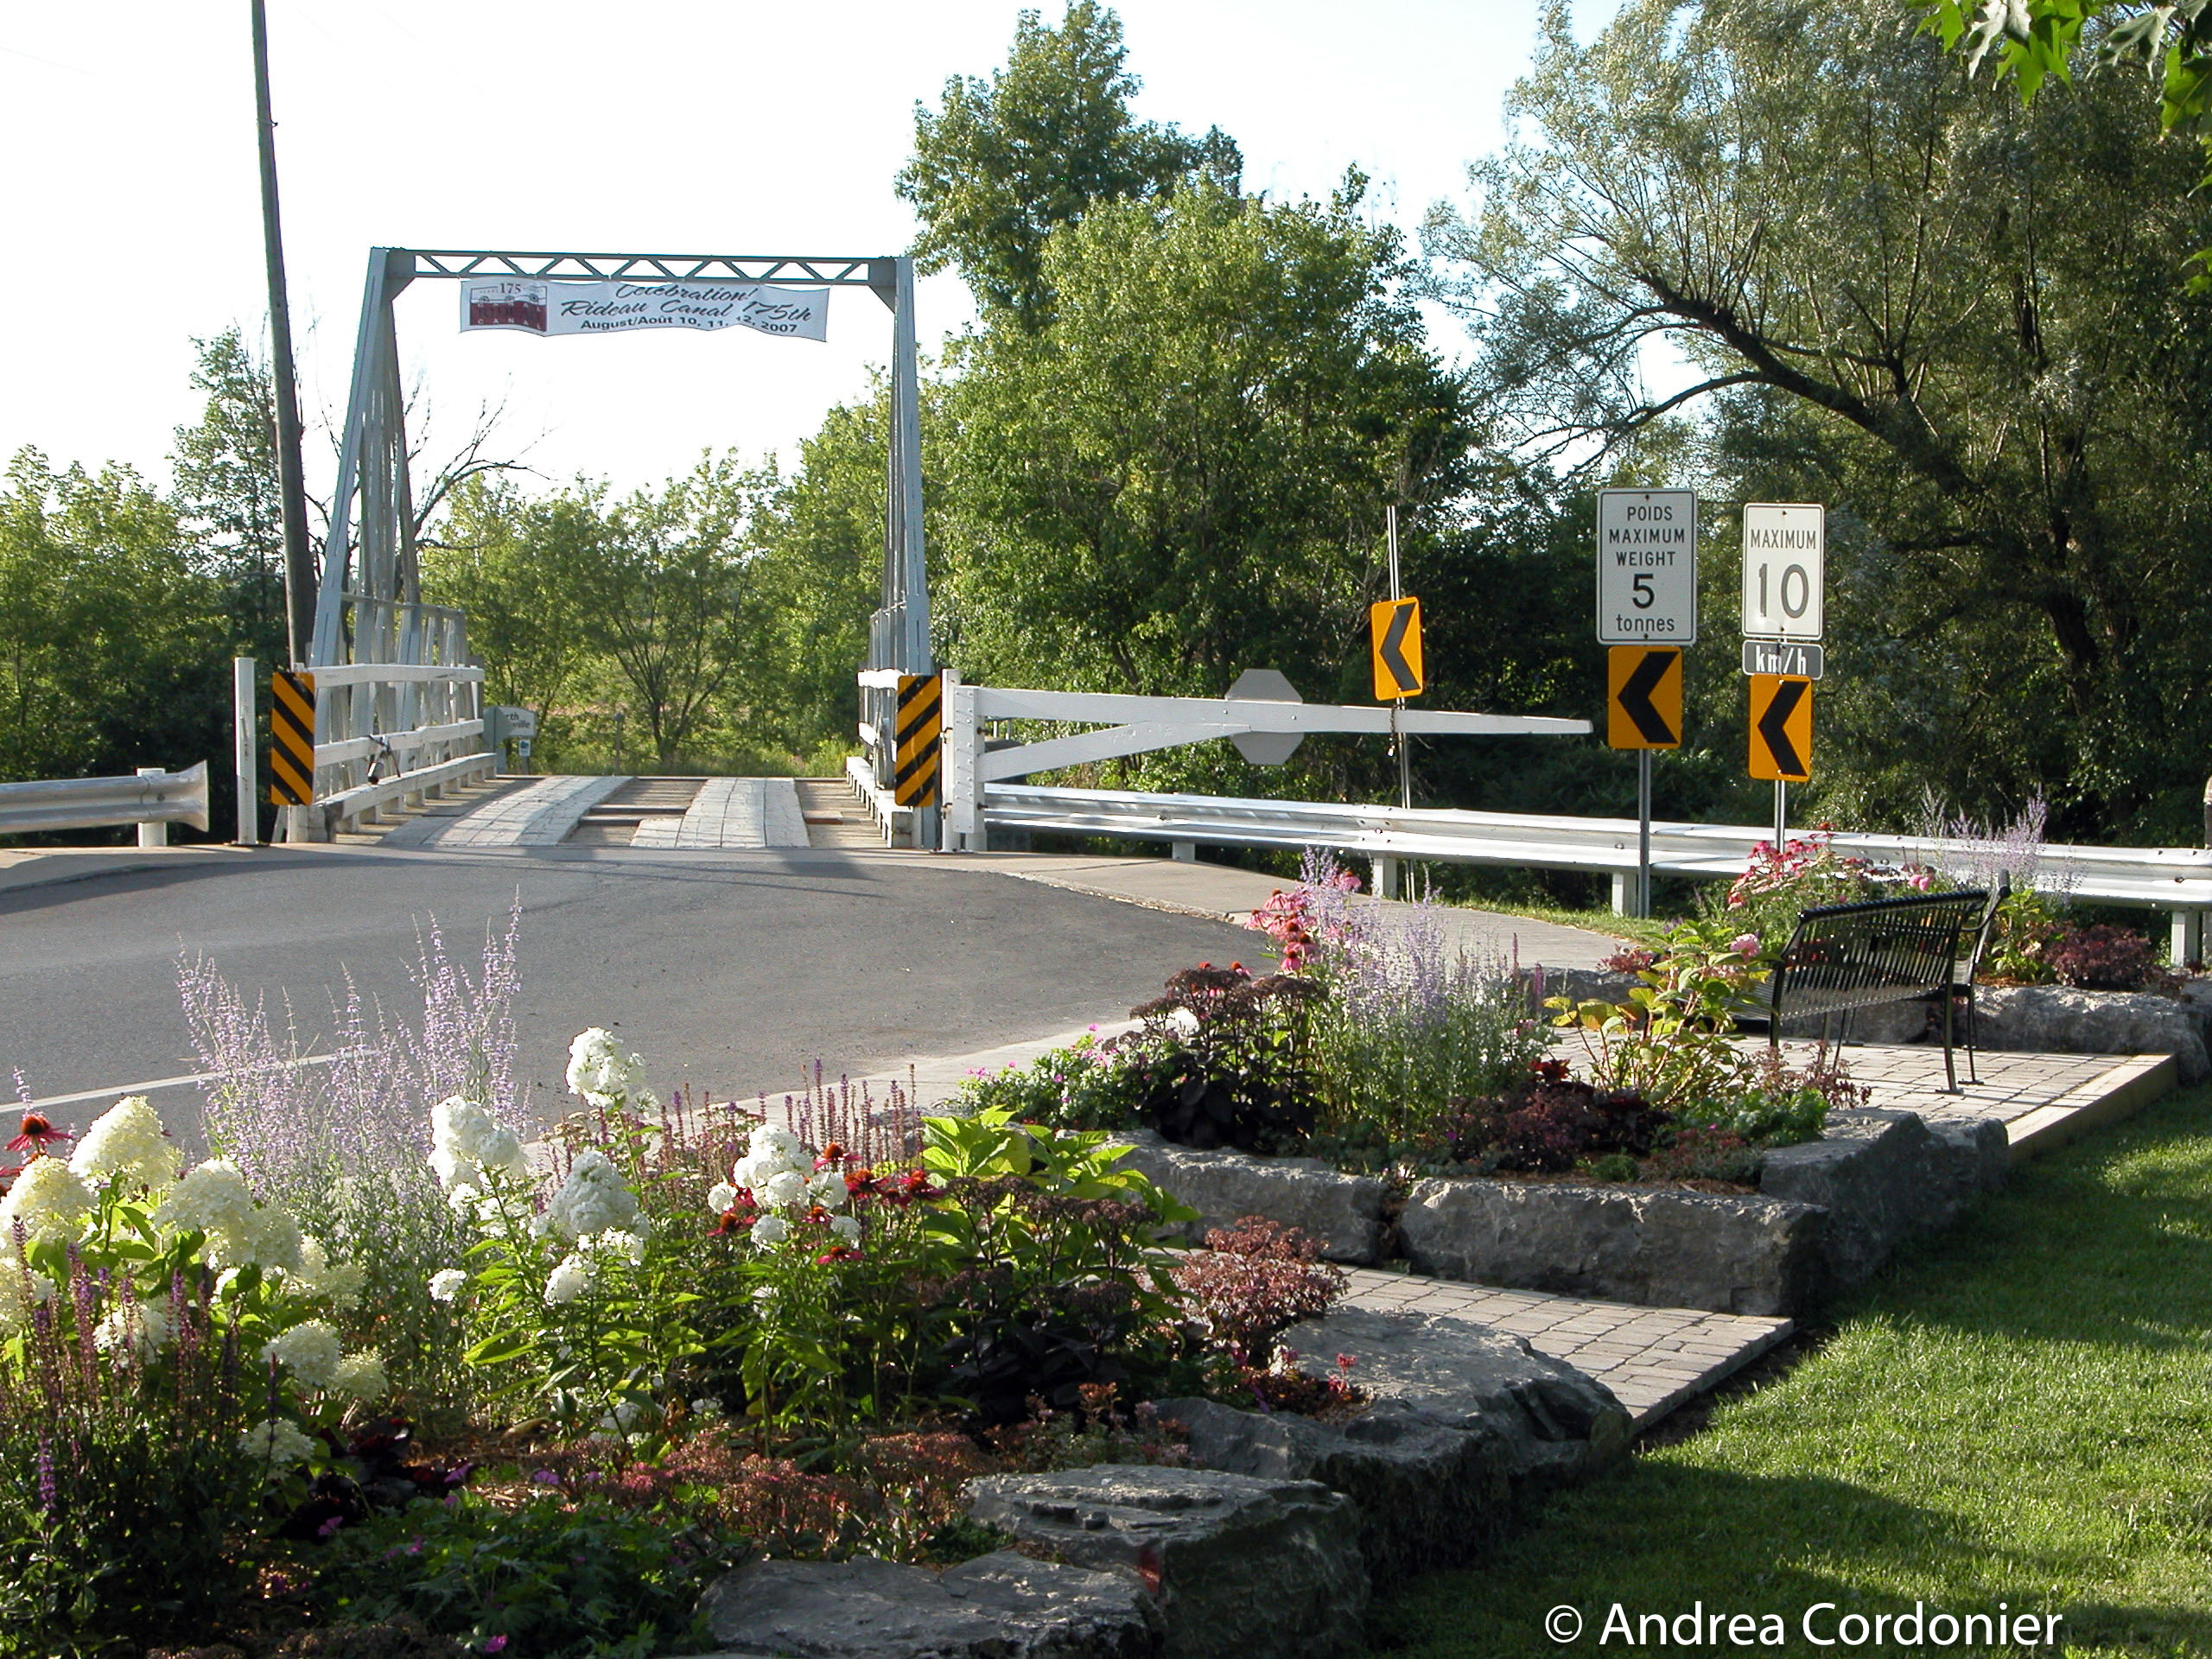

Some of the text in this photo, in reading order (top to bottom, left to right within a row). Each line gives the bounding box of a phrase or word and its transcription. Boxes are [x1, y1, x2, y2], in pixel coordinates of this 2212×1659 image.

[500, 283, 522, 294] 175
[615, 283, 759, 301] Celebration!
[561, 300, 648, 316] Rideau
[660, 299, 734, 317] Canal
[742, 301, 813, 321] 175th
[478, 317, 541, 329] CANAL
[581, 315, 673, 330] August/Août
[760, 321, 798, 333] 2007
[1626, 505, 1673, 521] POIDS
[1609, 528, 1685, 543] MAXIMUM
[1751, 529, 1816, 549] MAXIMUM
[1616, 551, 1675, 566] WEIGHT
[1632, 574, 1655, 608] 5
[1758, 563, 1809, 619] 10
[1616, 613, 1675, 632] tonnes
[1755, 645, 1807, 674] km/h
